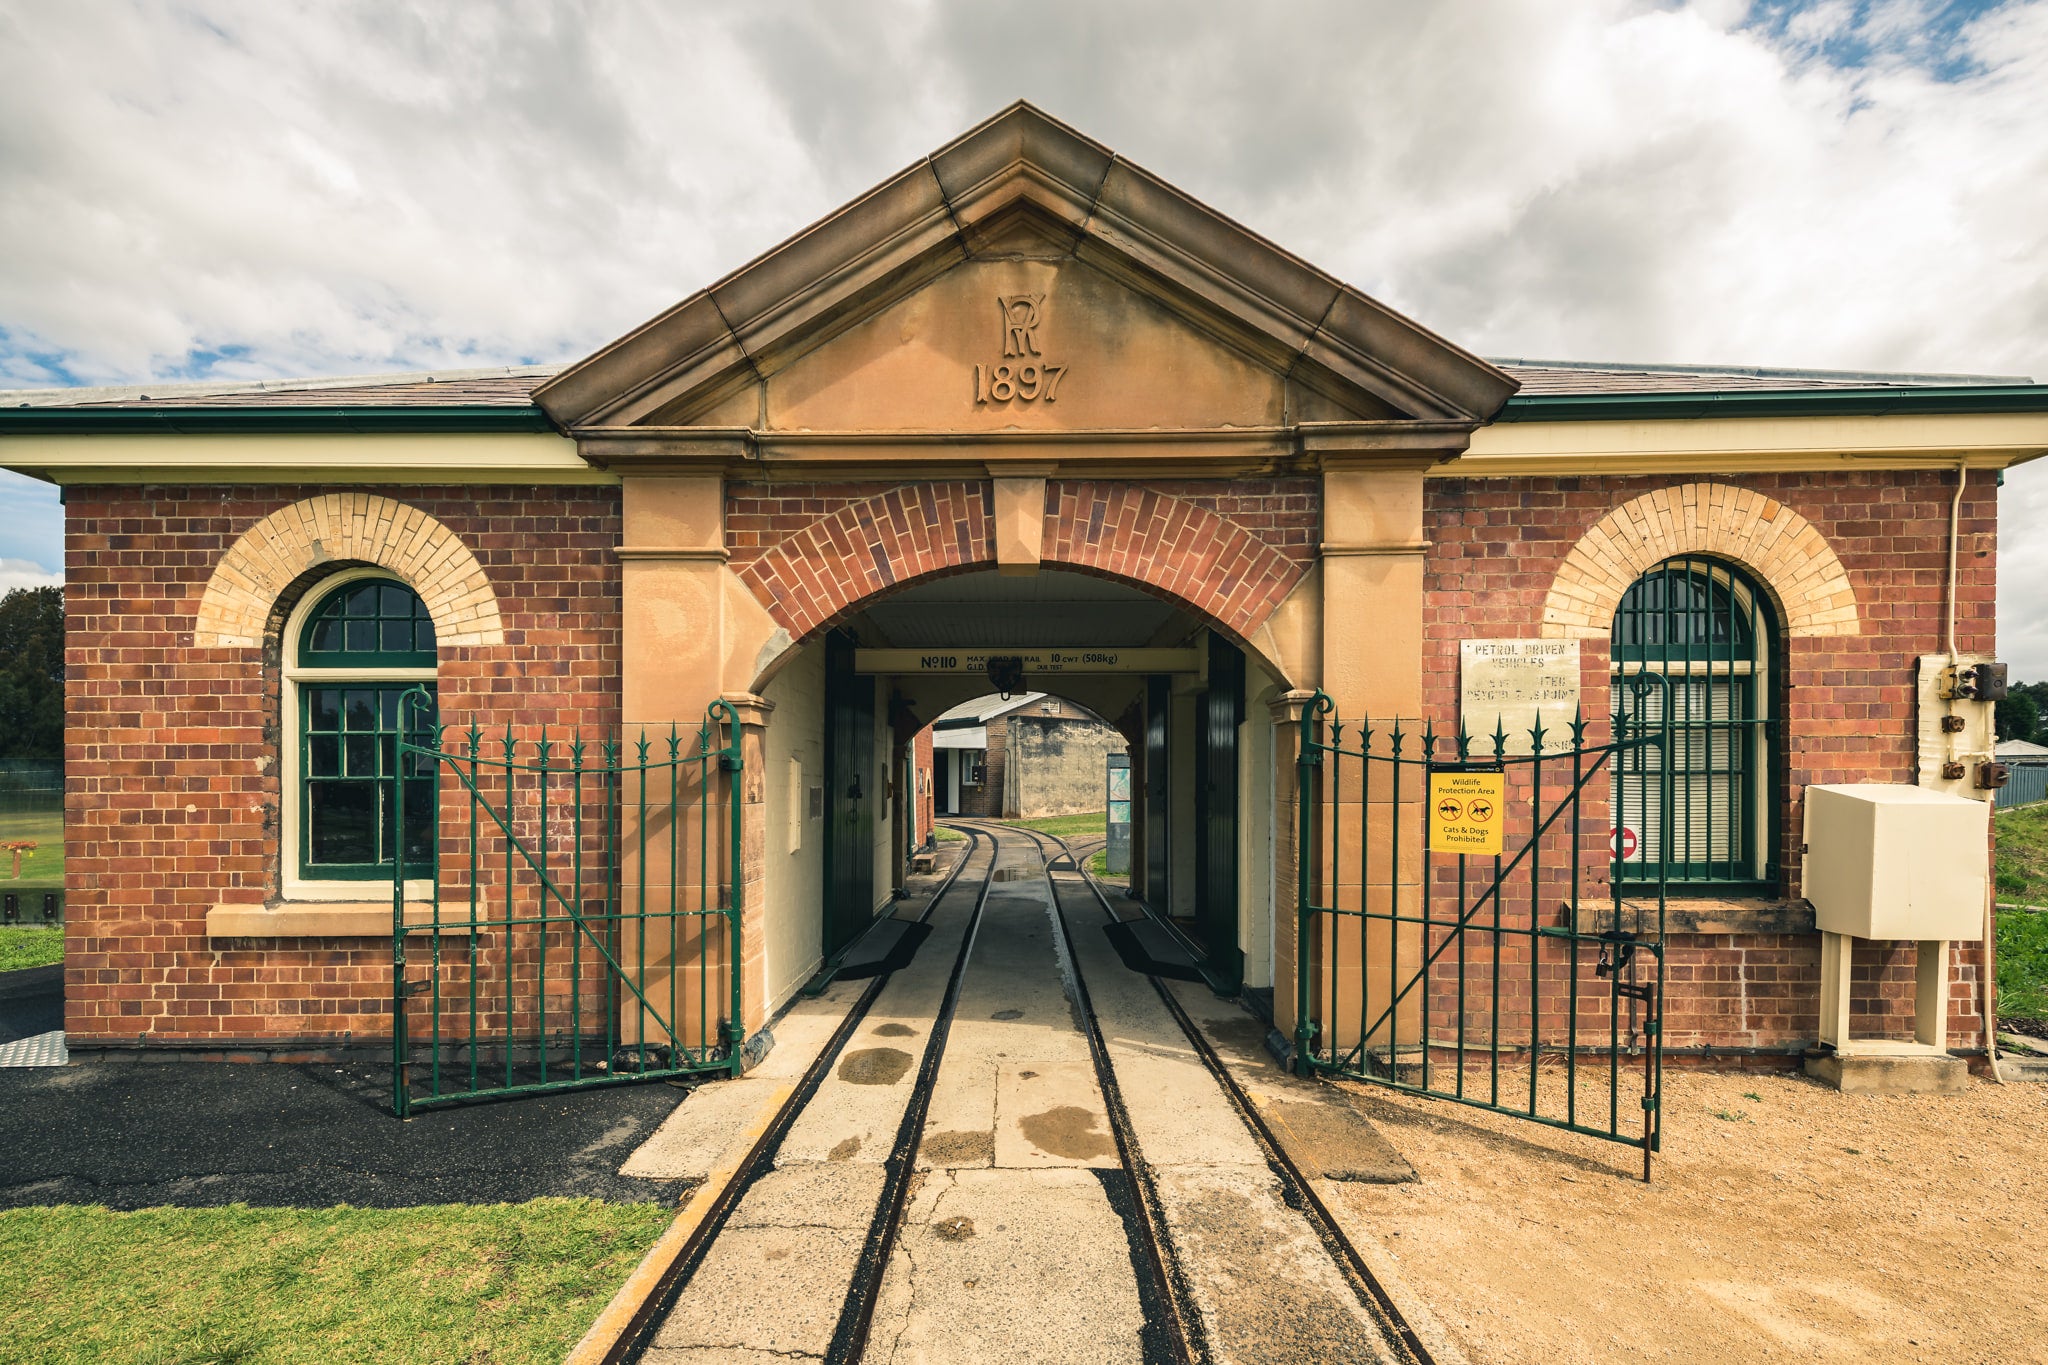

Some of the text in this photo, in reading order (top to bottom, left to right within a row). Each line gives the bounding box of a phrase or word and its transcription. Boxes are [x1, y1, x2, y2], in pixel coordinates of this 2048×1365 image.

[975, 363, 1069, 405] 1897
[1475, 644, 1565, 655] PETROL DRIVEN
[1082, 653, 1118, 665] (508kg)
[1452, 778, 1481, 786] Wildlife
[1438, 787, 1476, 795] Protection
[1469, 827, 1489, 836] Dogs
[1446, 834, 1486, 843] Prohibited
